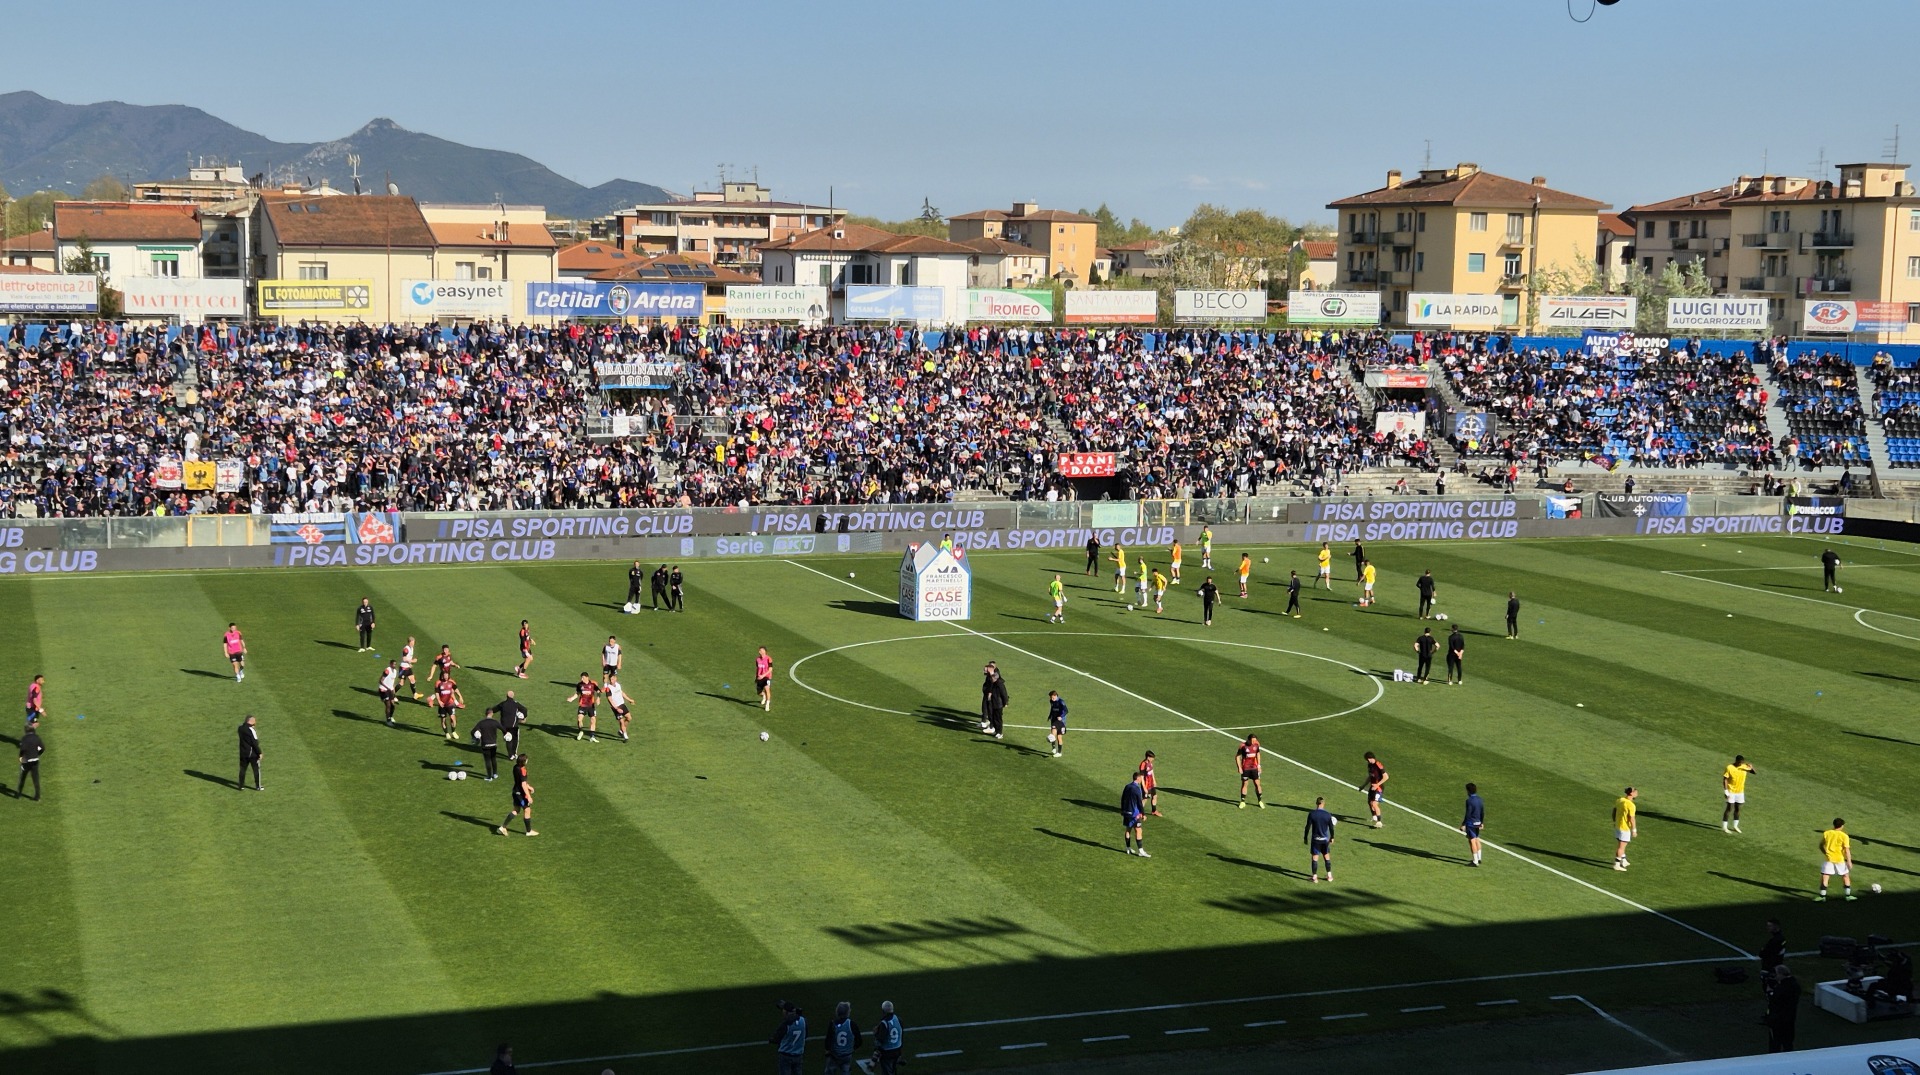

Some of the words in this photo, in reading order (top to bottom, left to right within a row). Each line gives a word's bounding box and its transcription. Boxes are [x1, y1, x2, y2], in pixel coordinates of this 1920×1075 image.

[265, 288, 274, 300] IL
[276, 288, 342, 300] FOTOAMATORE
[436, 284, 504, 300] easynet
[535, 290, 603, 308] Cetilar
[729, 289, 771, 300] Ranieri
[775, 289, 805, 300] Fochi
[132, 294, 237, 308] MATTEUCCI
[633, 292, 695, 309] Arena
[1069, 294, 1108, 306] SANTA
[1114, 294, 1153, 306] MARIA
[1193, 292, 1248, 309] BECO
[728, 306, 755, 314] Vendi
[787, 306, 806, 314] Pisa
[993, 304, 1041, 316] ROMEO
[1436, 305, 1452, 315] LA
[1454, 305, 1499, 315] RAPIDA
[1550, 307, 1628, 319] GILGEN
[1672, 302, 1718, 315] LUIGI
[1723, 303, 1763, 316] NUTI
[1820, 308, 1839, 318] RC
[1672, 317, 1762, 325] AUTOCARROZZERIA
[1586, 335, 1619, 346] AUTO
[1633, 337, 1669, 348] NOMO
[597, 364, 674, 376] GRADINATA
[620, 375, 651, 386] 1909
[1627, 495, 1682, 503] AUTONOMO
[1323, 503, 1365, 521] PISA
[1370, 502, 1463, 520] SPORTING
[1468, 501, 1517, 518] CLUB
[1795, 505, 1836, 515] PONSACCO
[452, 519, 505, 538] PISA
[511, 516, 629, 537] SPORTING
[635, 515, 694, 534] CLUB
[763, 513, 812, 532] PISA
[930, 510, 985, 529] CLUB
[1645, 517, 1687, 535] PISA
[1690, 515, 1783, 535] SPORTING
[1786, 516, 1844, 534] CLUB
[1315, 524, 1360, 542] PISA
[1365, 522, 1463, 541] SPORTING
[1468, 520, 1518, 538] CLUB
[953, 531, 1000, 550] PISA
[1006, 528, 1115, 549] SPORTING
[1120, 527, 1175, 546] CLUB
[288, 546, 348, 566] PISA
[355, 541, 485, 565] SPORTING
[491, 540, 556, 561] CLUB
[716, 538, 764, 555] Serie
[24, 550, 98, 573] CLUB
[925, 591, 962, 603] CASE
[924, 607, 962, 617] SOGNI
[792, 1030, 802, 1045] 7
[836, 1031, 848, 1046] 6
[889, 1027, 899, 1043] 9
[1869, 1058, 1915, 1072] PISA
